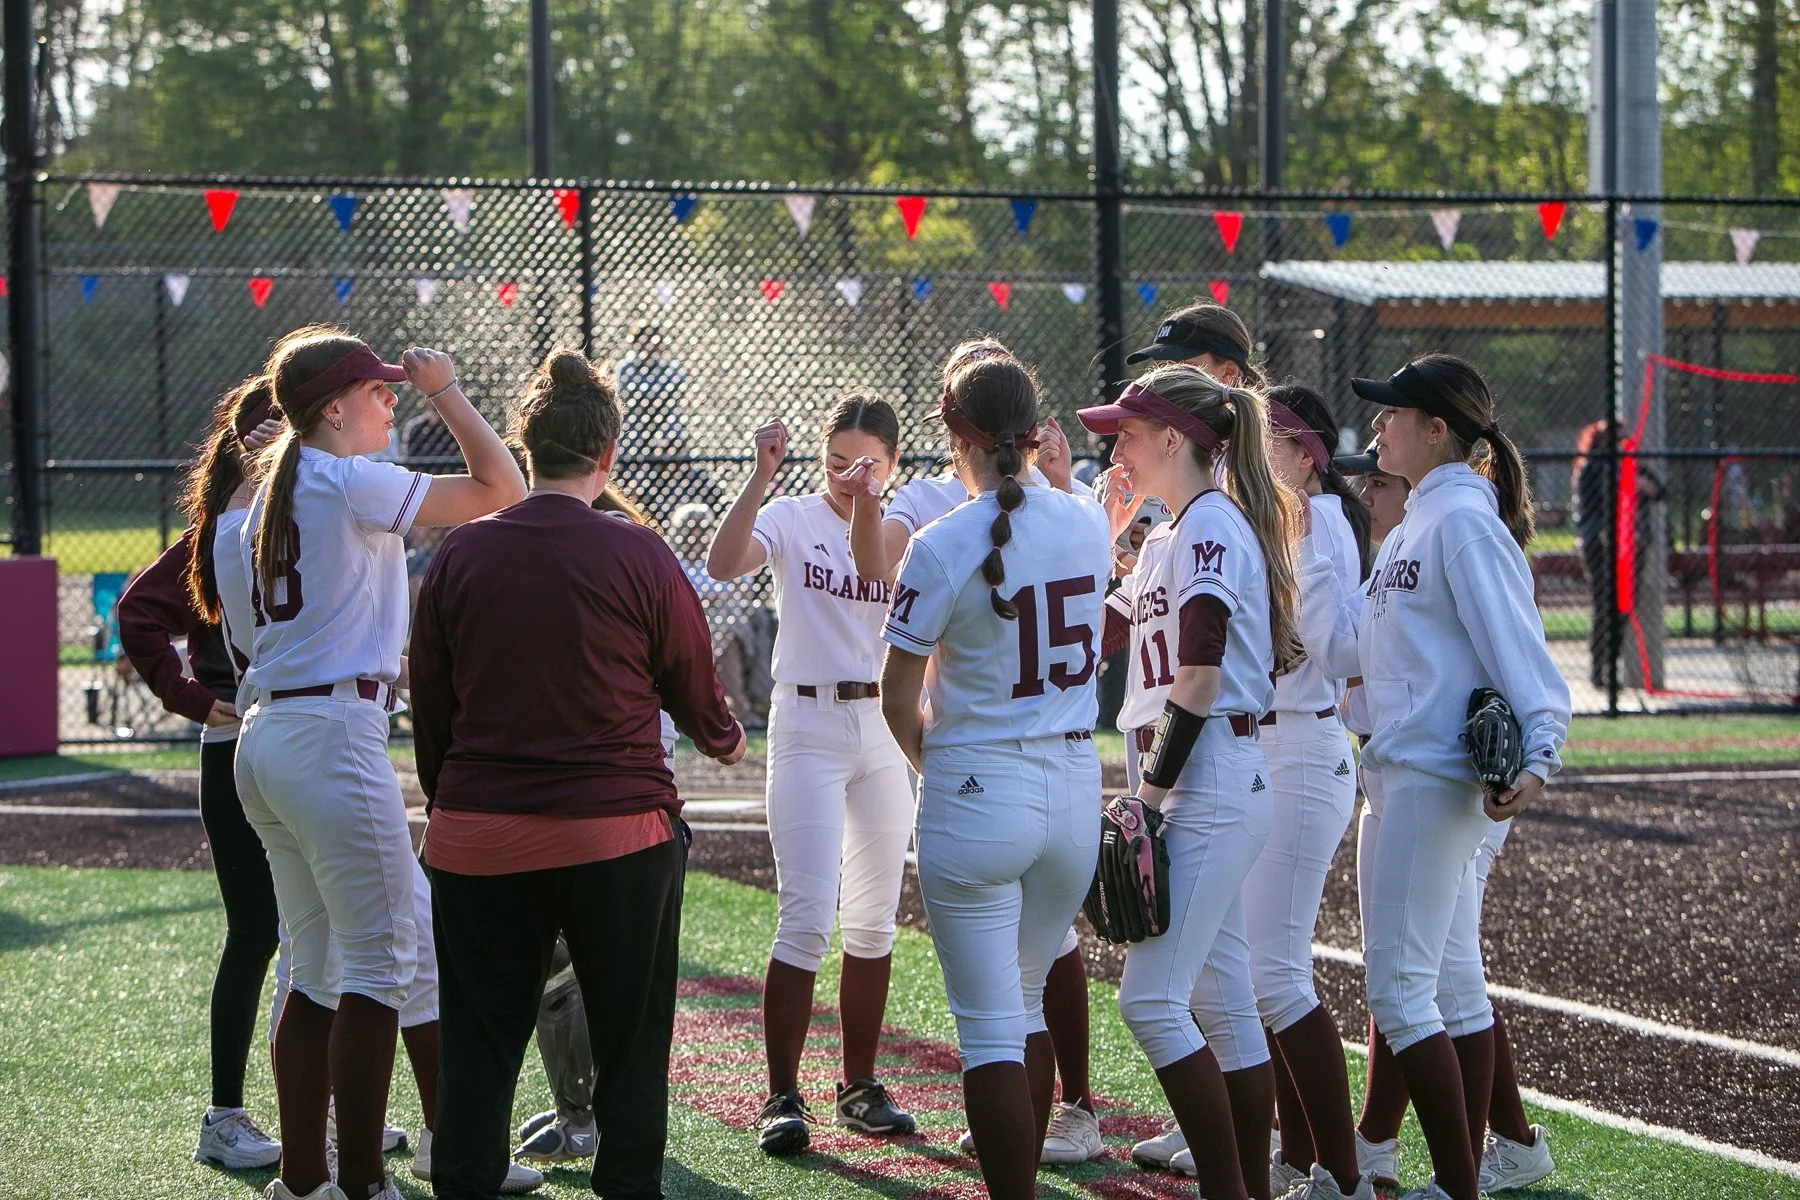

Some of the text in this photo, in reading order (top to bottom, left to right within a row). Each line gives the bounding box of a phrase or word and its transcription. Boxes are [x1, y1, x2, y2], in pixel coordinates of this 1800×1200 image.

[1011, 574, 1097, 699] 15
[1140, 629, 1175, 690] 11
[957, 786, 985, 796] adidas
